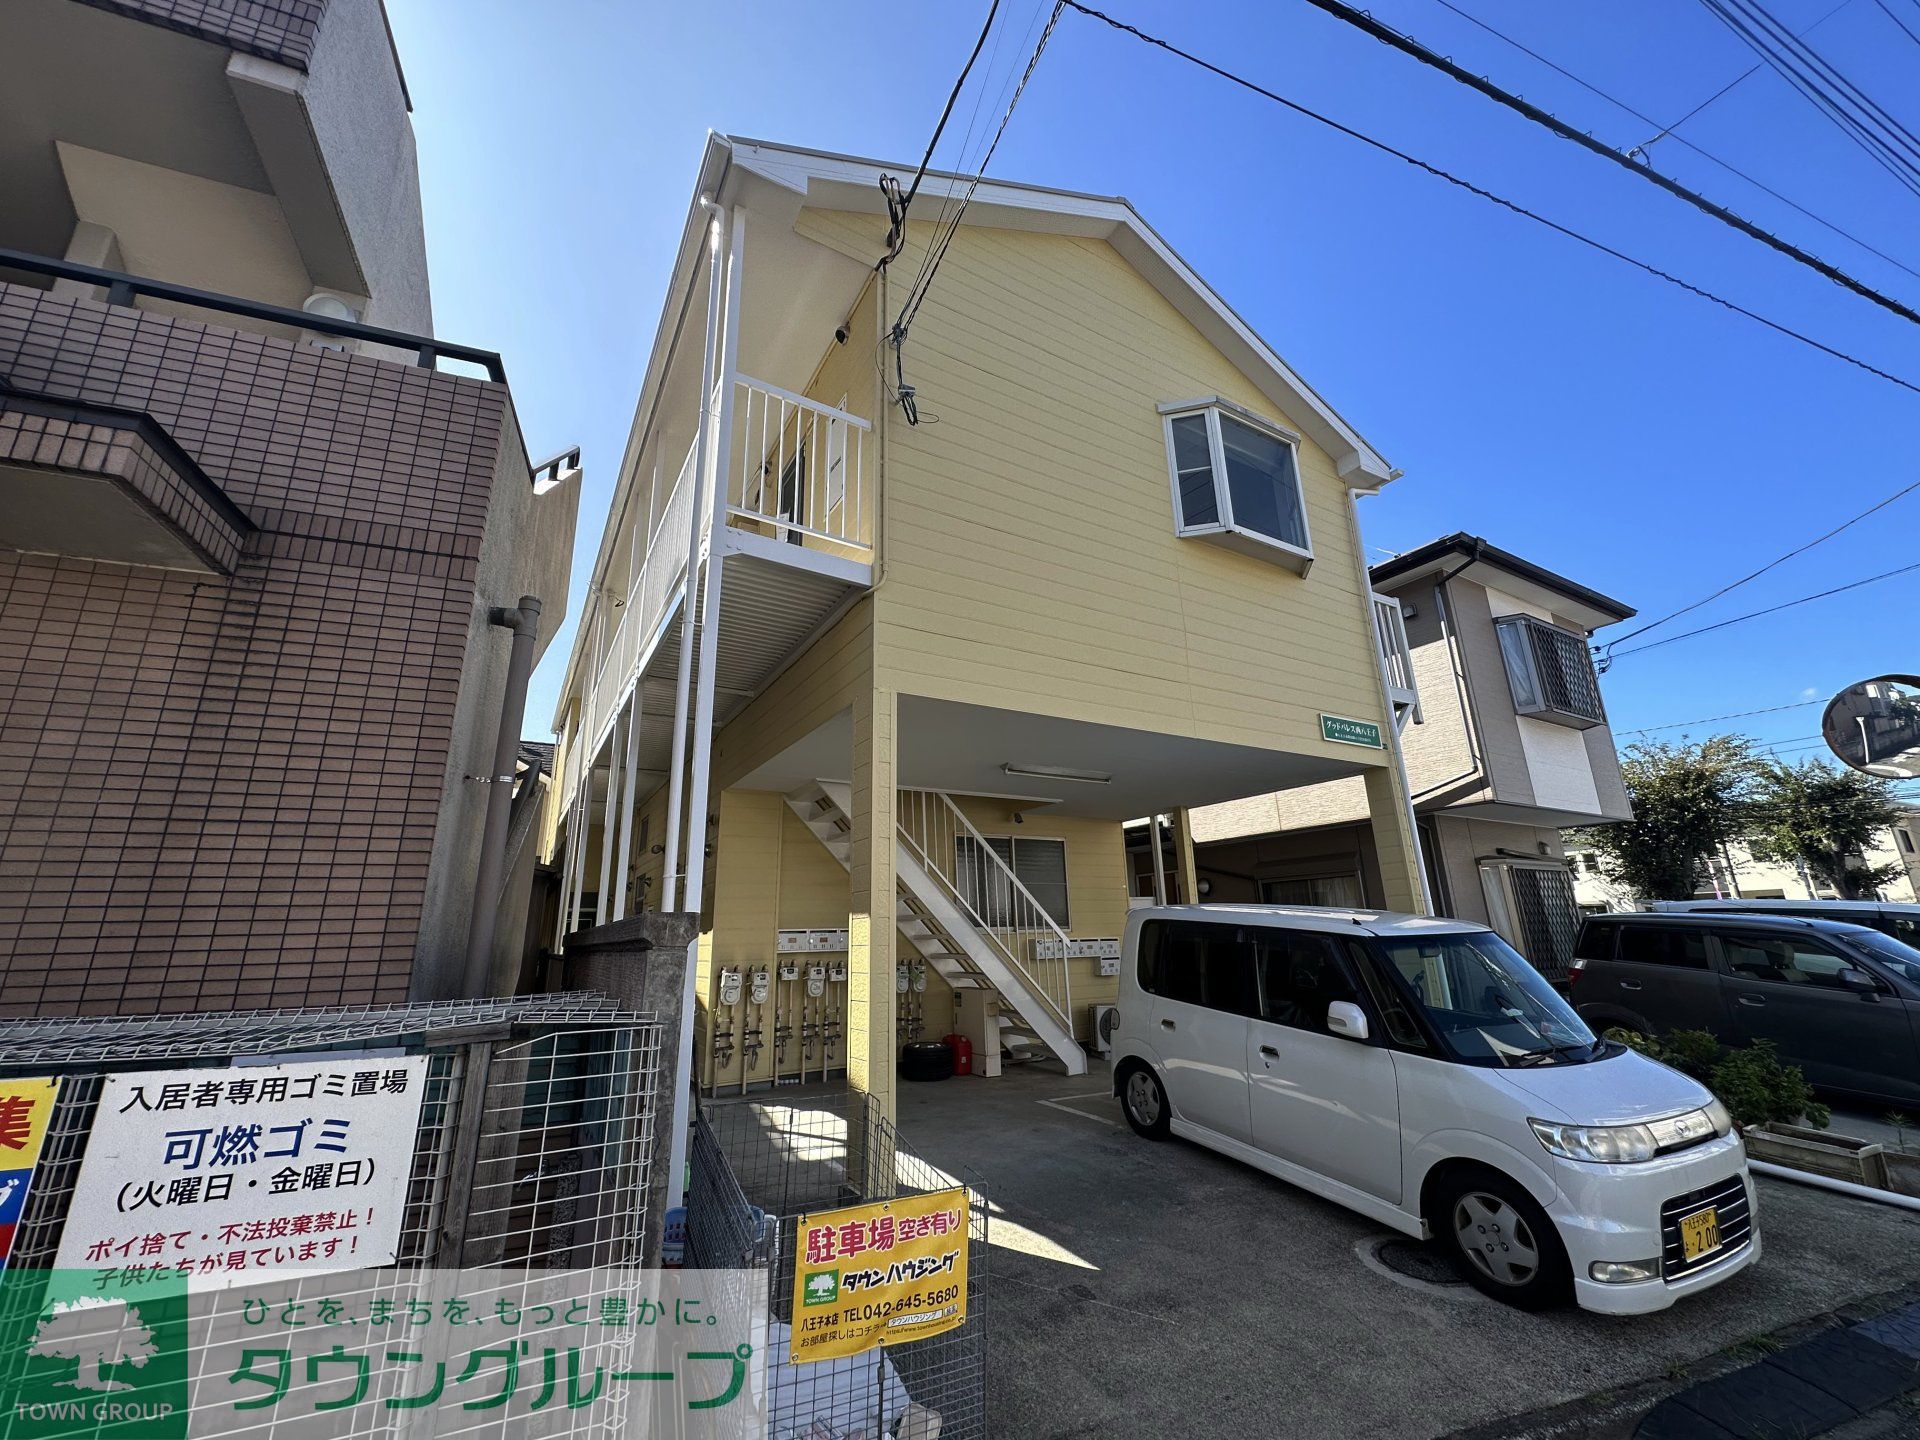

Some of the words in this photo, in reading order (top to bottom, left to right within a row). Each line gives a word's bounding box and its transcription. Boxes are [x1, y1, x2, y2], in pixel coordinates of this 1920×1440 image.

[119, 1068, 409, 1113] 入居者専用ゴミ置場
[163, 1117, 351, 1170] 可燃ゴミ
[116, 1157, 375, 1212] （火曜日・金曜日）
[85, 1207, 374, 1262] ポイ捨て・不法投棄禁止！
[806, 1216, 895, 1264] 駐車場
[898, 1209, 961, 1242] 空き有り
[92, 1235, 358, 1291] 子供たちが見ています！
[842, 1250, 959, 1292] タウンハウジング
[801, 1313, 840, 1332] 八王子本店
[844, 1307, 862, 1322] TEL
[863, 1284, 959, 1320] 042-645-5680
